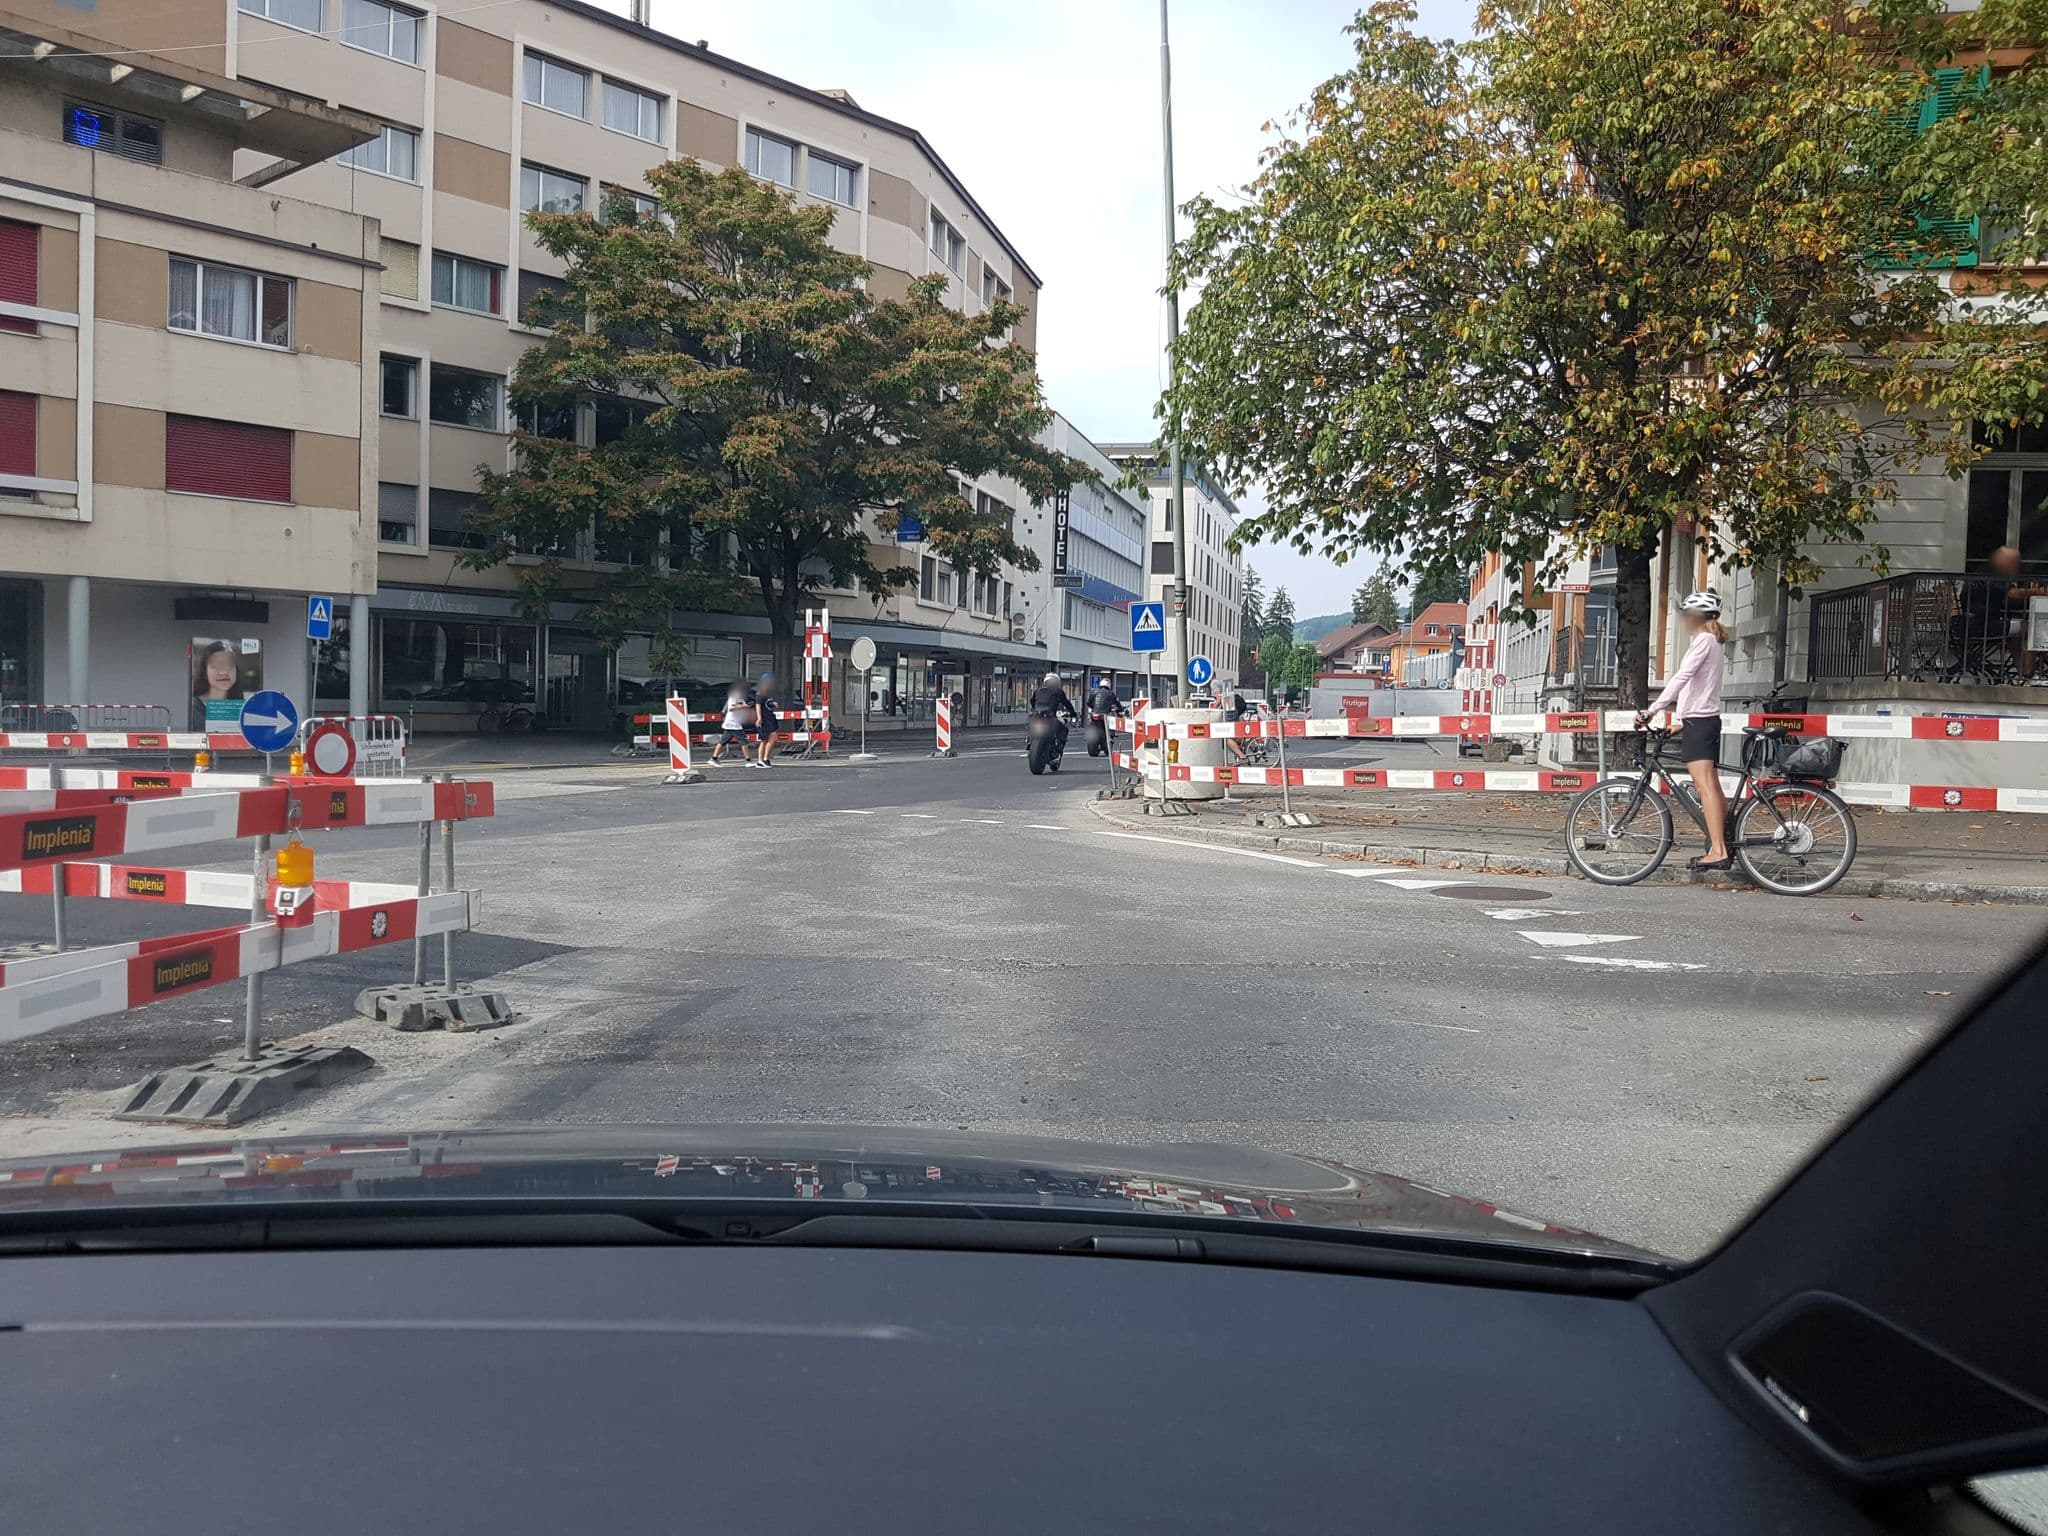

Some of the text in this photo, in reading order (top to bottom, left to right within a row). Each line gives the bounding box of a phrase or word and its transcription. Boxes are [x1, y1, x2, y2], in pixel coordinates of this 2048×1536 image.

[1056, 497, 1067, 570] HOTEL
[1343, 699, 1368, 708] Frutiger
[1560, 718, 1588, 728] Implenia
[1552, 777, 1581, 788] Implenia
[28, 825, 92, 853] Implenia
[128, 876, 164, 893] Implenia
[157, 961, 209, 986] Implenia
